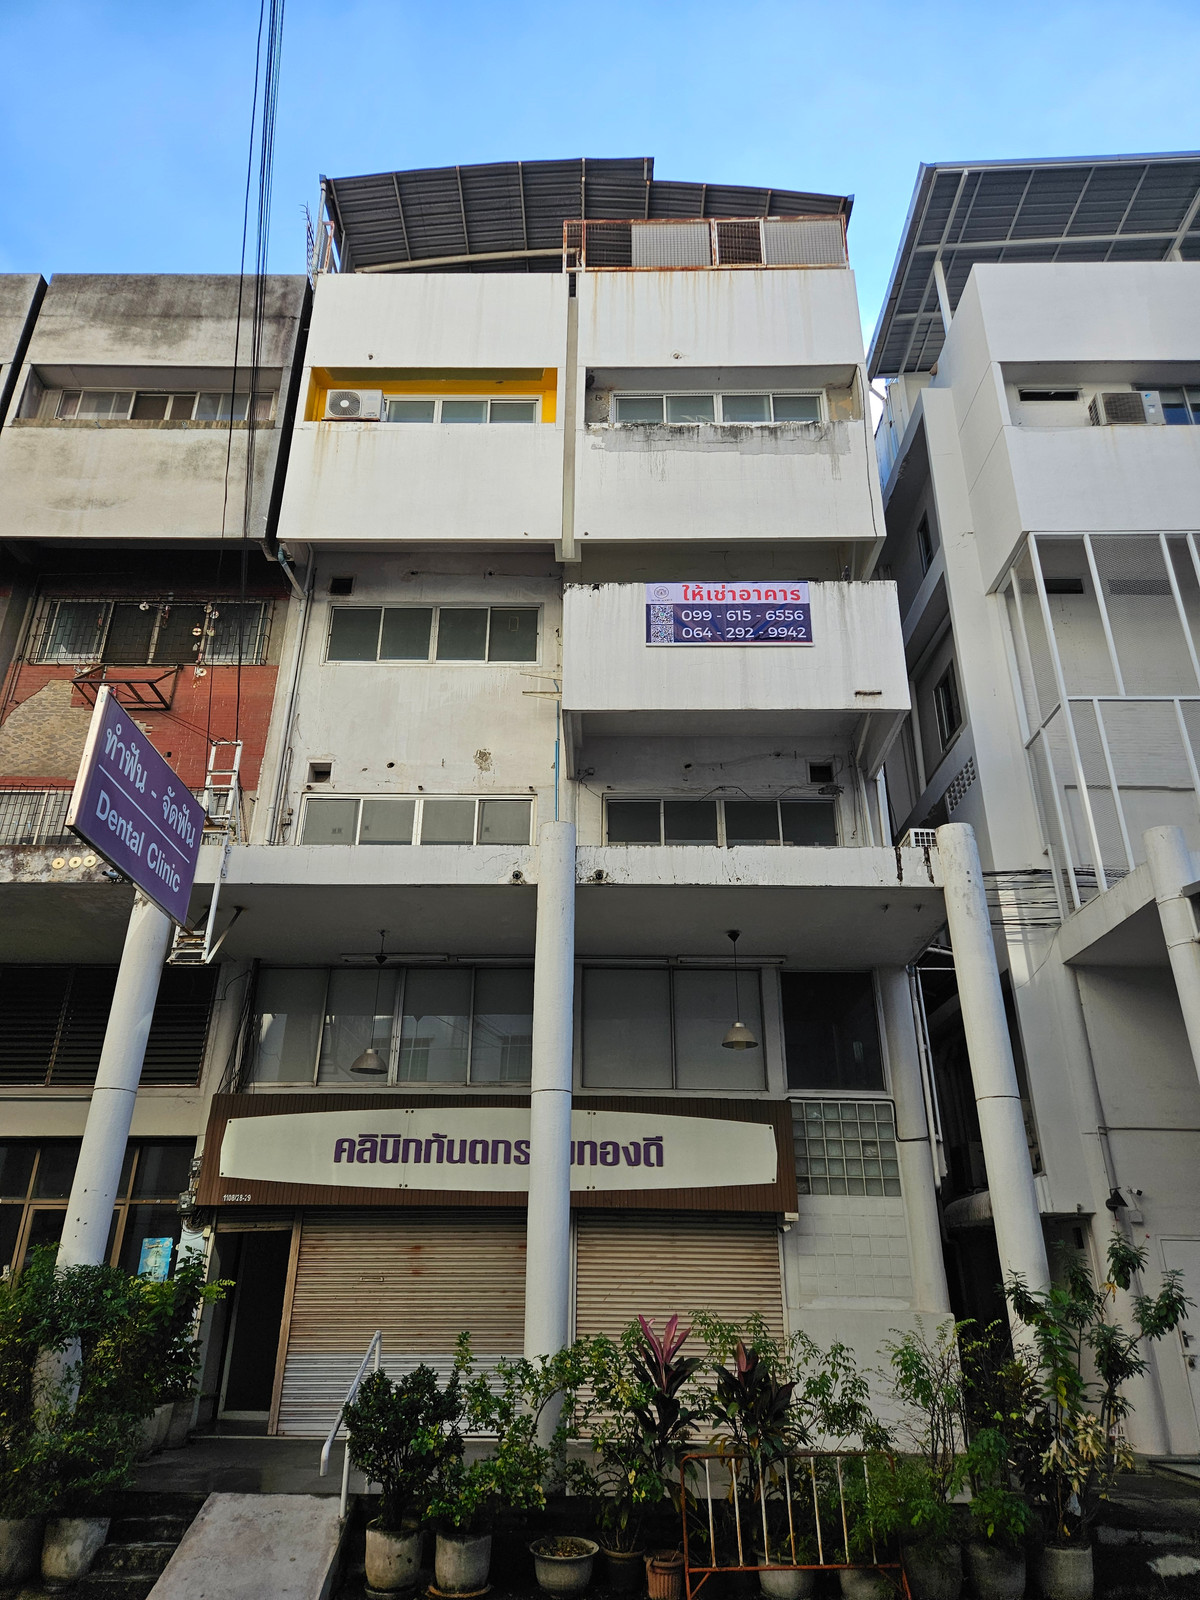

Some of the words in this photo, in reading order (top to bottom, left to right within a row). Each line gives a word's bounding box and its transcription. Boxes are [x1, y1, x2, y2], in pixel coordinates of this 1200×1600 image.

[682, 585, 801, 601] ให้เช่าอาคาร
[682, 610, 712, 621] 099
[726, 610, 752, 621] 615
[765, 610, 804, 621] 6556
[682, 627, 713, 638] 064
[726, 627, 755, 638] 292
[768, 627, 807, 638] 9942
[104, 723, 147, 794] ทำฟัน
[162, 786, 196, 849] จัดฟัน
[95, 789, 145, 857] Dental
[146, 842, 181, 893] Clinic
